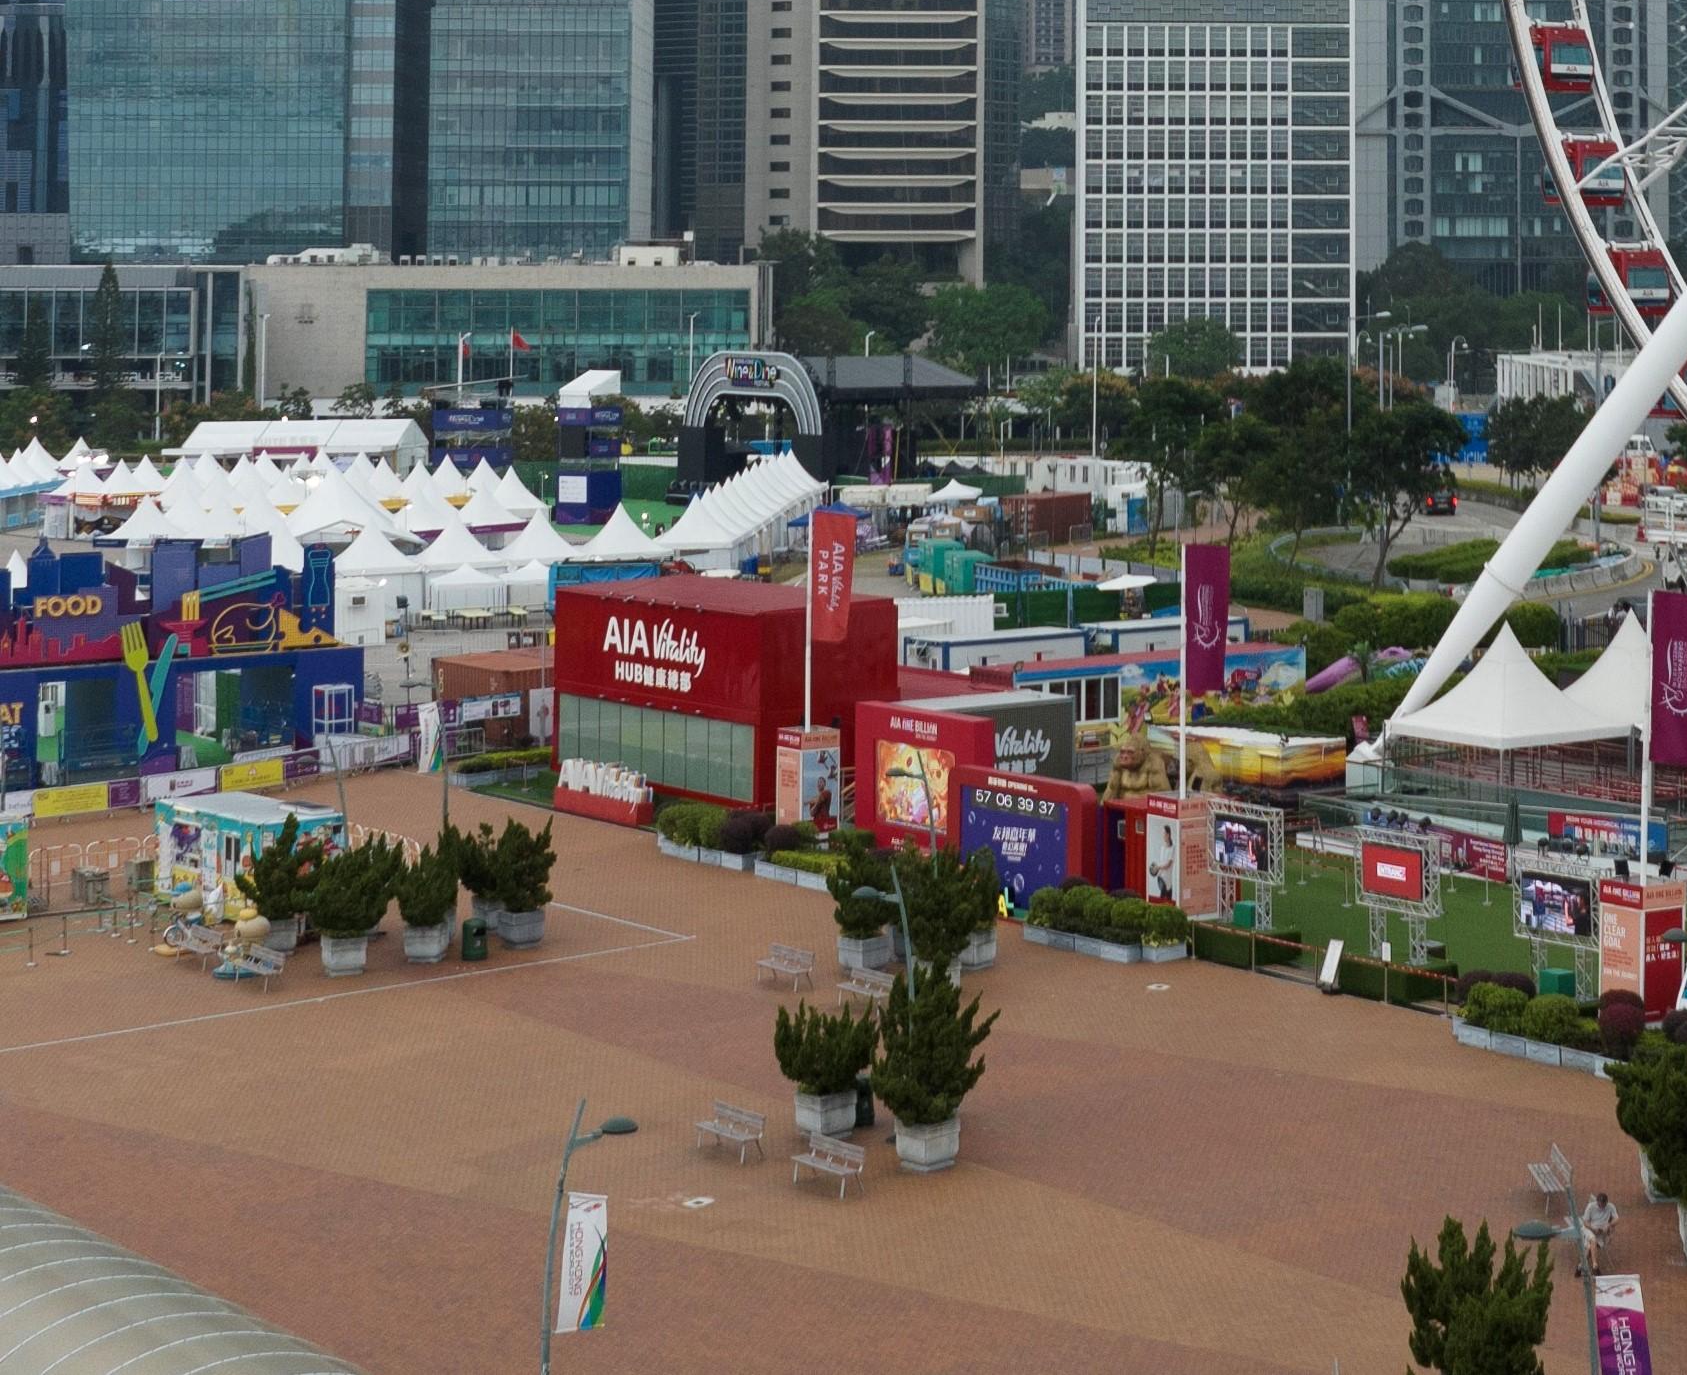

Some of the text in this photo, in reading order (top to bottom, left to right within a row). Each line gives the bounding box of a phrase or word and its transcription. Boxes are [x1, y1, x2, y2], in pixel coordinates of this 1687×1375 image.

[817, 549, 829, 596] PARK
[831, 541, 846, 574] AIA
[34, 594, 102, 618] FOOD
[603, 616, 706, 678] AIA Vitality
[994, 726, 1051, 762] Vitality
[975, 788, 1055, 816] 57 06 39 37
[1603, 924, 1626, 939] CLEAR
[1604, 912, 1617, 926] ONE
[1603, 936, 1622, 949] GOAL
[572, 1221, 584, 1297] HONG KONG
[1617, 1316, 1637, 1367] HONG
